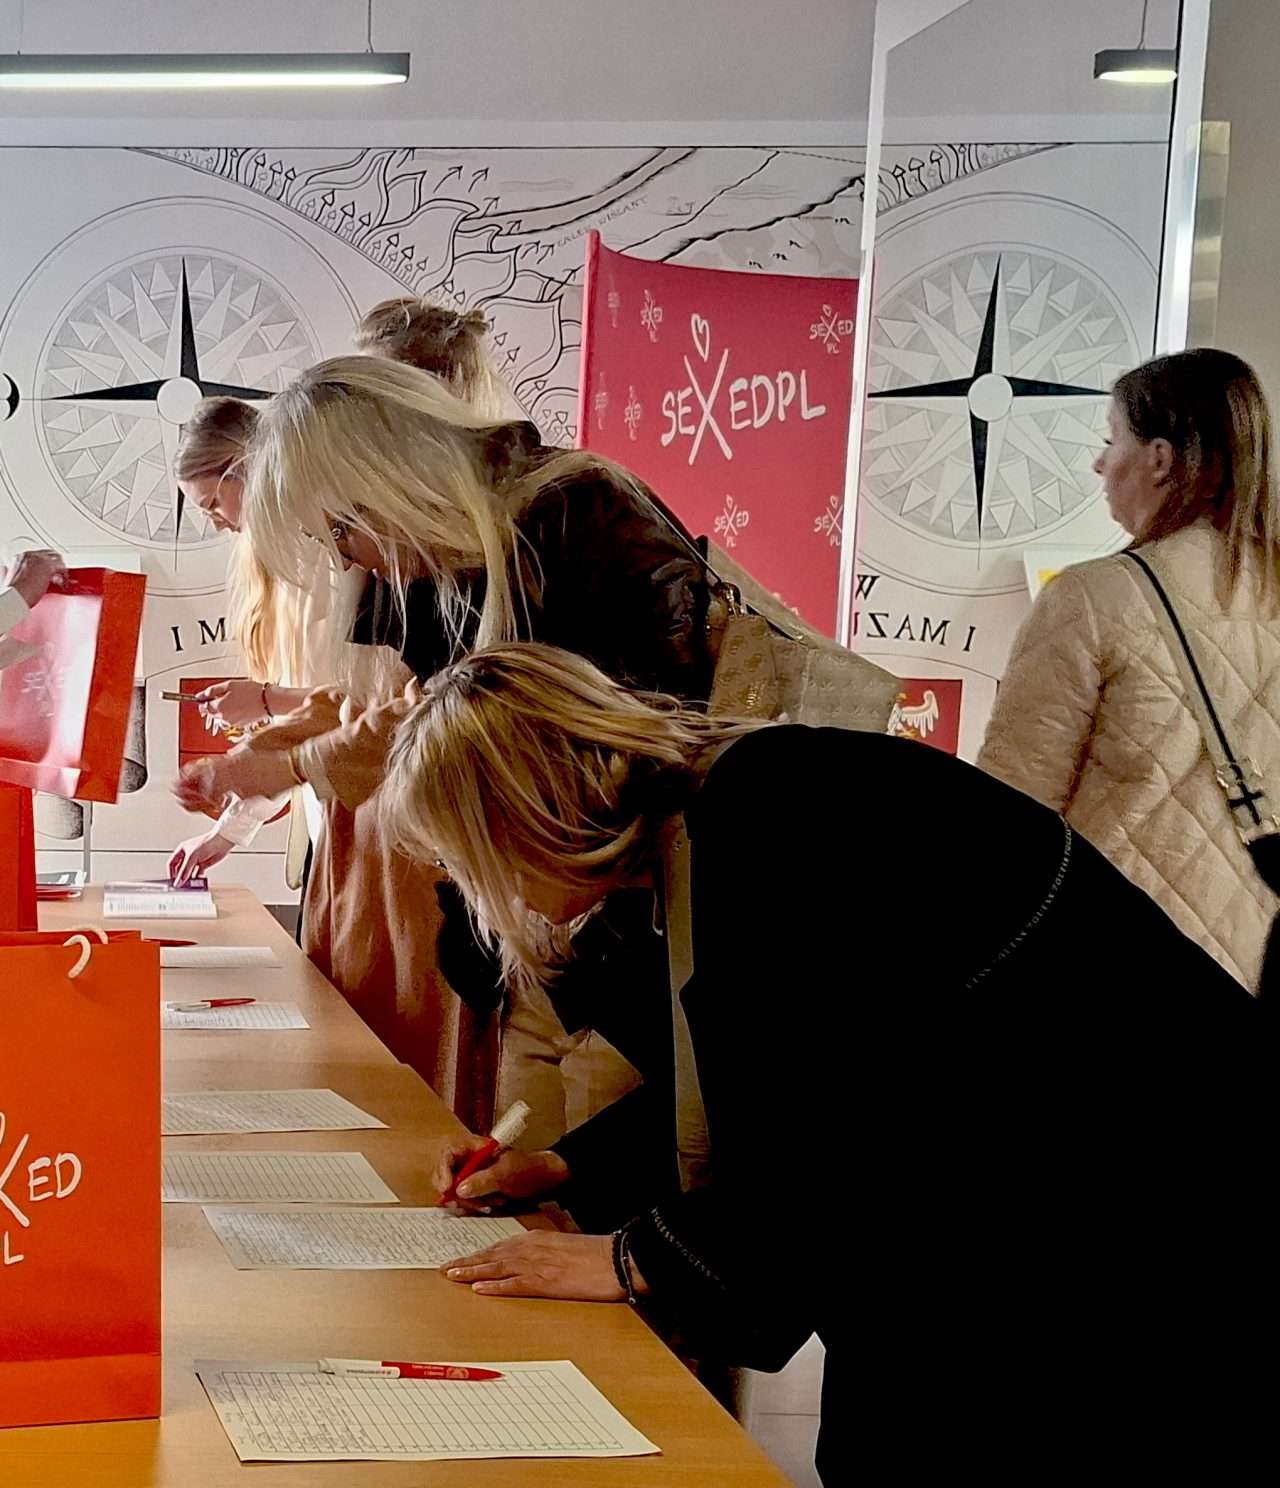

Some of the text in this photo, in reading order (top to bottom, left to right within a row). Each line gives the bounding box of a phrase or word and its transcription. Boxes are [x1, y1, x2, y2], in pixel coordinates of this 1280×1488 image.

[809, 312, 854, 344] SEXED
[660, 347, 826, 466] SEXEDPL
[713, 505, 750, 537] SEXED
